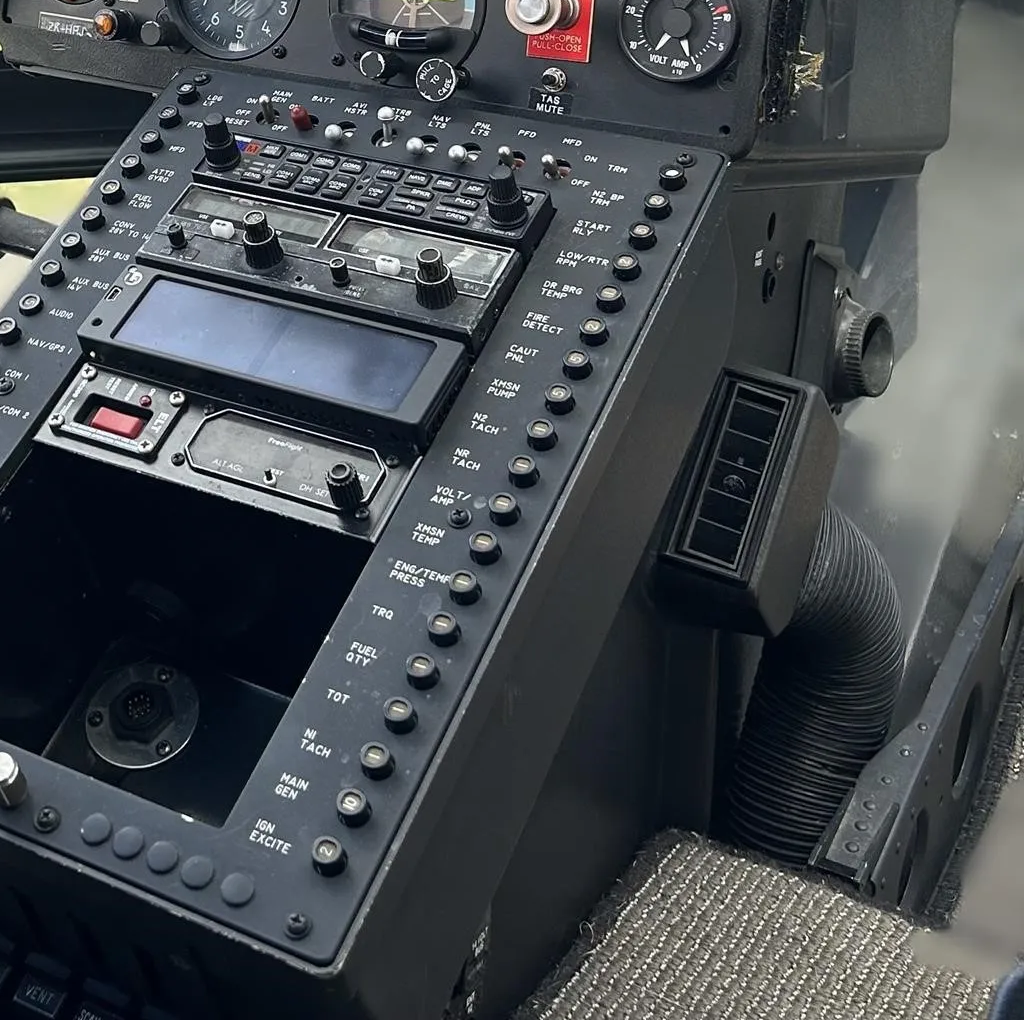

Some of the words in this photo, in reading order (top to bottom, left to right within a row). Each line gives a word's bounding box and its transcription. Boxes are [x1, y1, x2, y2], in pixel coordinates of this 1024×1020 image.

[532, 40, 582, 52] PULL-CLOSE
[649, 54, 667, 64] VOLT
[671, 58, 689, 68] AMP
[420, 64, 435, 80] PULL
[431, 75, 440, 85] TO
[438, 78, 452, 96] CAGE
[311, 95, 335, 103] BATT
[540, 94, 560, 105] TAS
[344, 108, 368, 116] MSTR
[536, 104, 564, 114] MUTE
[432, 114, 451, 123] NAV
[428, 120, 448, 130] LTS
[474, 122, 492, 130] PNL
[470, 128, 490, 136] LTS
[518, 130, 536, 138] PFD
[562, 138, 582, 146] MFD
[152, 169, 174, 177] ATTD
[608, 164, 628, 174] TRM
[148, 175, 169, 183] GYRO
[570, 178, 590, 188] OFF
[133, 194, 153, 202] FUEL
[411, 188, 431, 197] SPKR
[592, 190, 609, 198] N2
[612, 194, 624, 202] BP
[128, 201, 152, 209] FLOW
[455, 197, 475, 206] PILOT
[590, 197, 610, 206] TRM
[446, 212, 466, 221] CREW
[113, 220, 135, 229] CONV
[576, 220, 612, 232] START
[128, 229, 140, 237] TO
[572, 227, 594, 237] RLY
[93, 248, 110, 257] AUX
[114, 251, 131, 261] BUS
[559, 250, 610, 266] LOW/RTR
[556, 258, 578, 268] RPM
[72, 277, 89, 285] AUX
[92, 280, 110, 290] BUS
[544, 280, 560, 290] DR
[563, 285, 584, 296] BRG
[541, 288, 568, 300] TEMP
[49, 309, 74, 320] AUDIO
[526, 312, 550, 323] FIRE
[522, 320, 563, 335] DETECT
[27, 338, 66, 353] NAV/GPS
[509, 344, 539, 356] CAUT
[505, 352, 526, 363] PNL
[4, 369, 23, 378] COM
[491, 378, 521, 391] XMSN
[487, 387, 517, 399] PUMP
[22, 411, 30, 420] 2
[473, 412, 488, 422] N2
[151, 411, 170, 433] ELT
[470, 421, 500, 435] TACH
[455, 448, 470, 458] NR
[212, 459, 226, 467] ALT
[451, 456, 481, 471] TACH
[299, 483, 313, 492] DH
[436, 485, 471, 501] VOLT/
[430, 495, 454, 506] AMP
[415, 522, 445, 538] XMSN
[412, 532, 440, 546] TEMP
[394, 560, 451, 584] ENG/TEMP
[389, 570, 425, 588] PRESS
[372, 605, 394, 620] TRQ
[350, 642, 378, 659] FUEL
[346, 652, 371, 667] QTY
[327, 689, 351, 704] TOT
[300, 739, 332, 758] TACH
[280, 772, 309, 791] MAIN
[275, 784, 299, 800] GEN
[255, 818, 276, 834] IGN
[249, 830, 292, 855] EXCITE
[26, 984, 54, 1005] VENT
